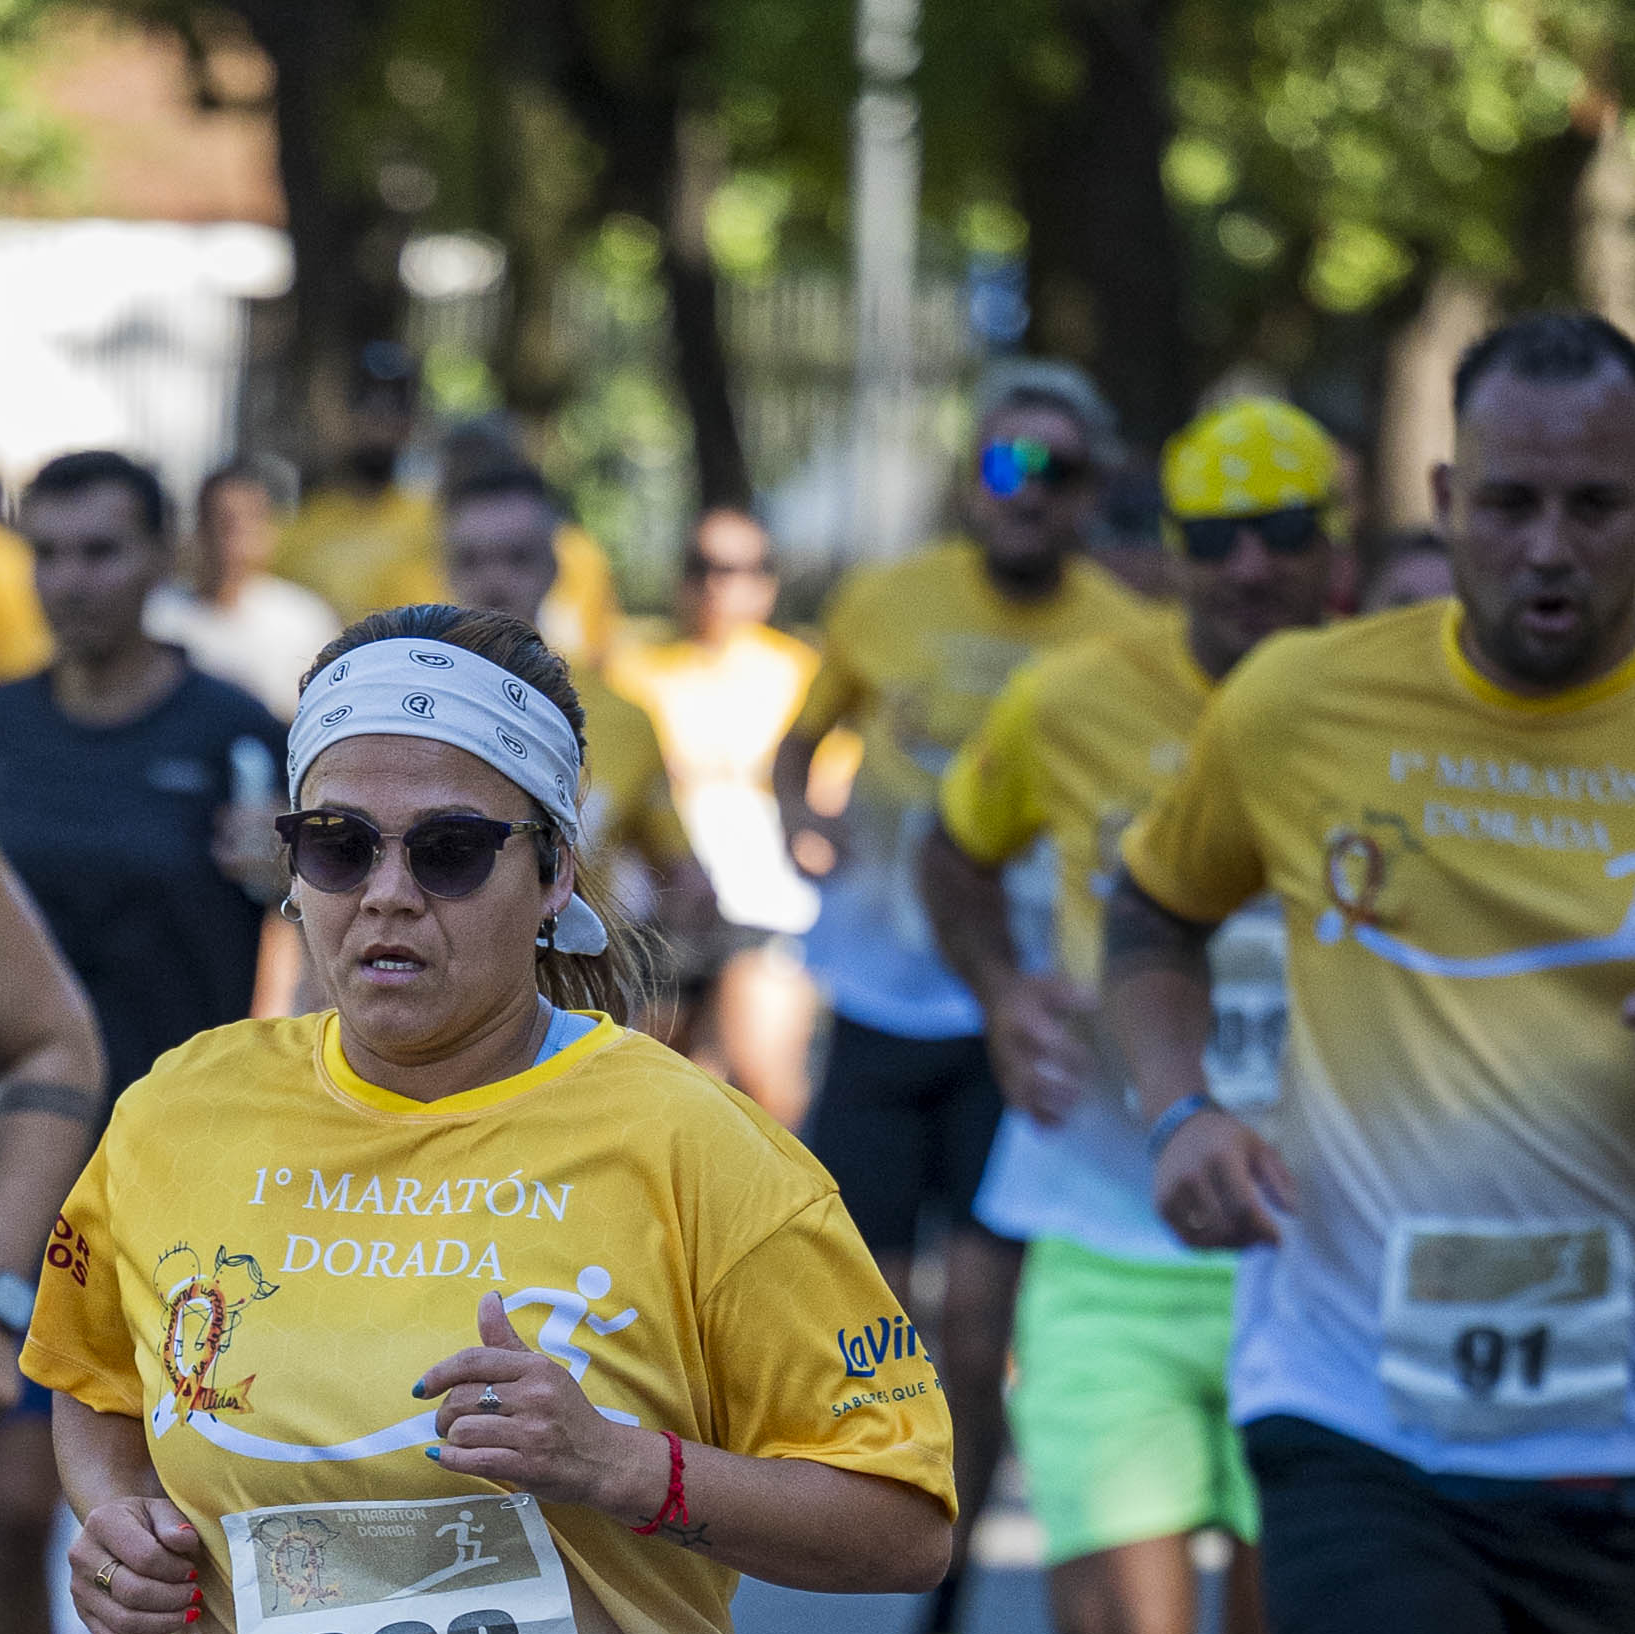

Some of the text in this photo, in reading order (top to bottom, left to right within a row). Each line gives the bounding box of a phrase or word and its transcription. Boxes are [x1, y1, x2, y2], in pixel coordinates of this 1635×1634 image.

[302, 1168, 574, 1222] MARATÓN
[279, 1233, 506, 1281] DORADA
[1452, 1322, 1550, 1398] 91
[892, 1381, 927, 1402] QUE
[357, 1524, 417, 1537] DORADA
